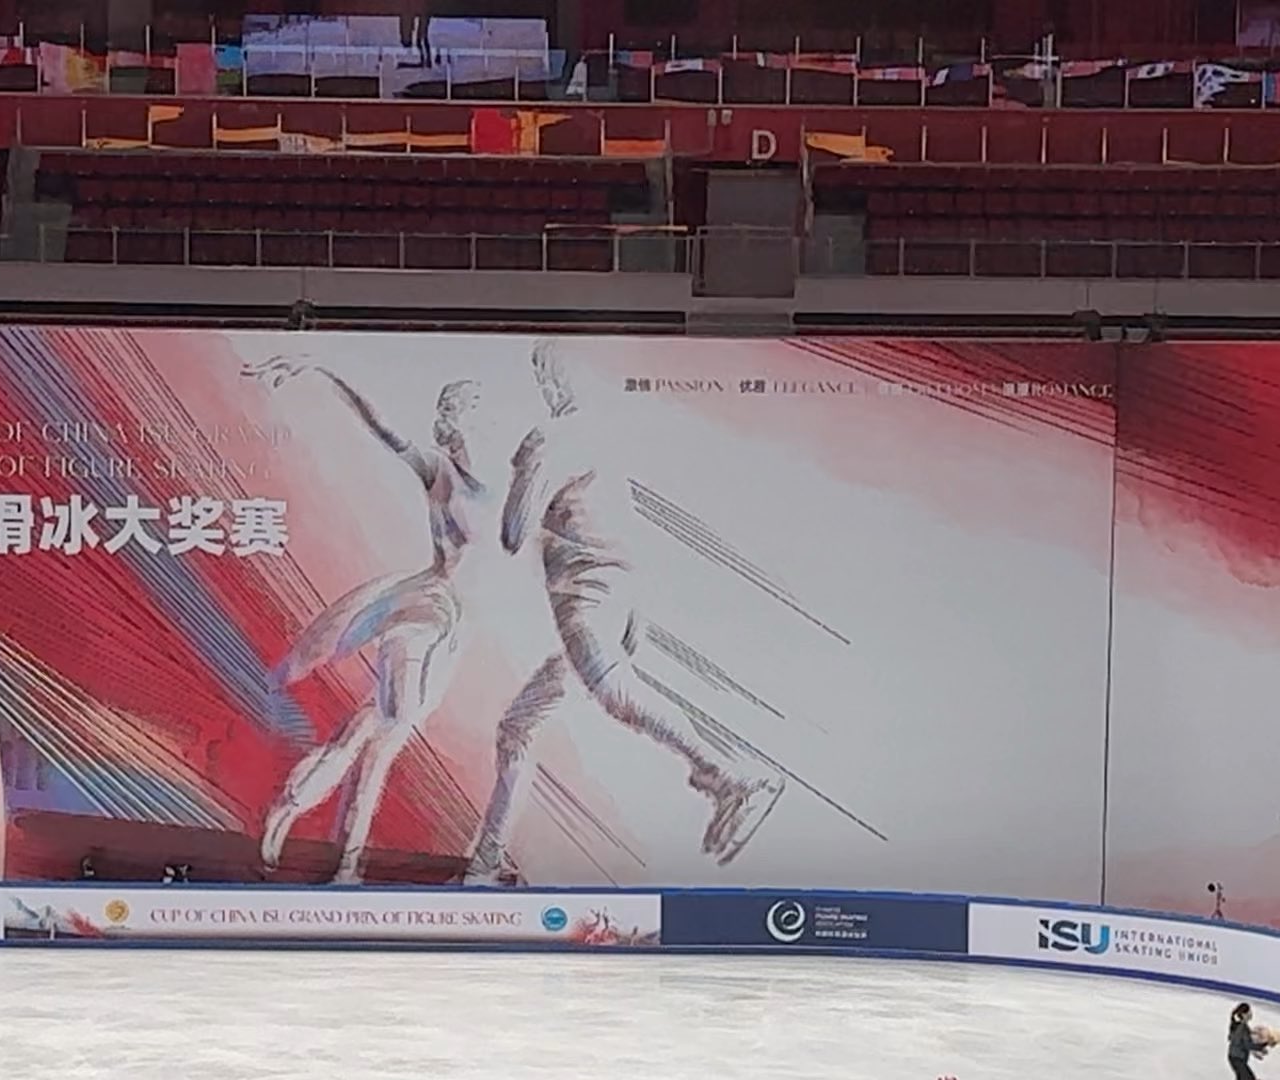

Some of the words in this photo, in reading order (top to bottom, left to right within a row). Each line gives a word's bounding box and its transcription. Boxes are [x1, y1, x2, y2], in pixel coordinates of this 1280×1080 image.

[752, 130, 776, 159] D
[150, 908, 181, 924] CUP
[185, 908, 207, 924] OF
[210, 908, 258, 924] CHINA
[262, 908, 284, 924] ISU
[288, 908, 343, 924] GRAND
[346, 910, 379, 925] PRIX
[382, 910, 402, 925] OF
[407, 911, 459, 926] FIGURE
[462, 911, 524, 926] SKATING
[1038, 918, 1111, 955] ISU
[1114, 929, 1218, 953] INTERNATIONAL
[1114, 942, 1172, 959] SKATING
